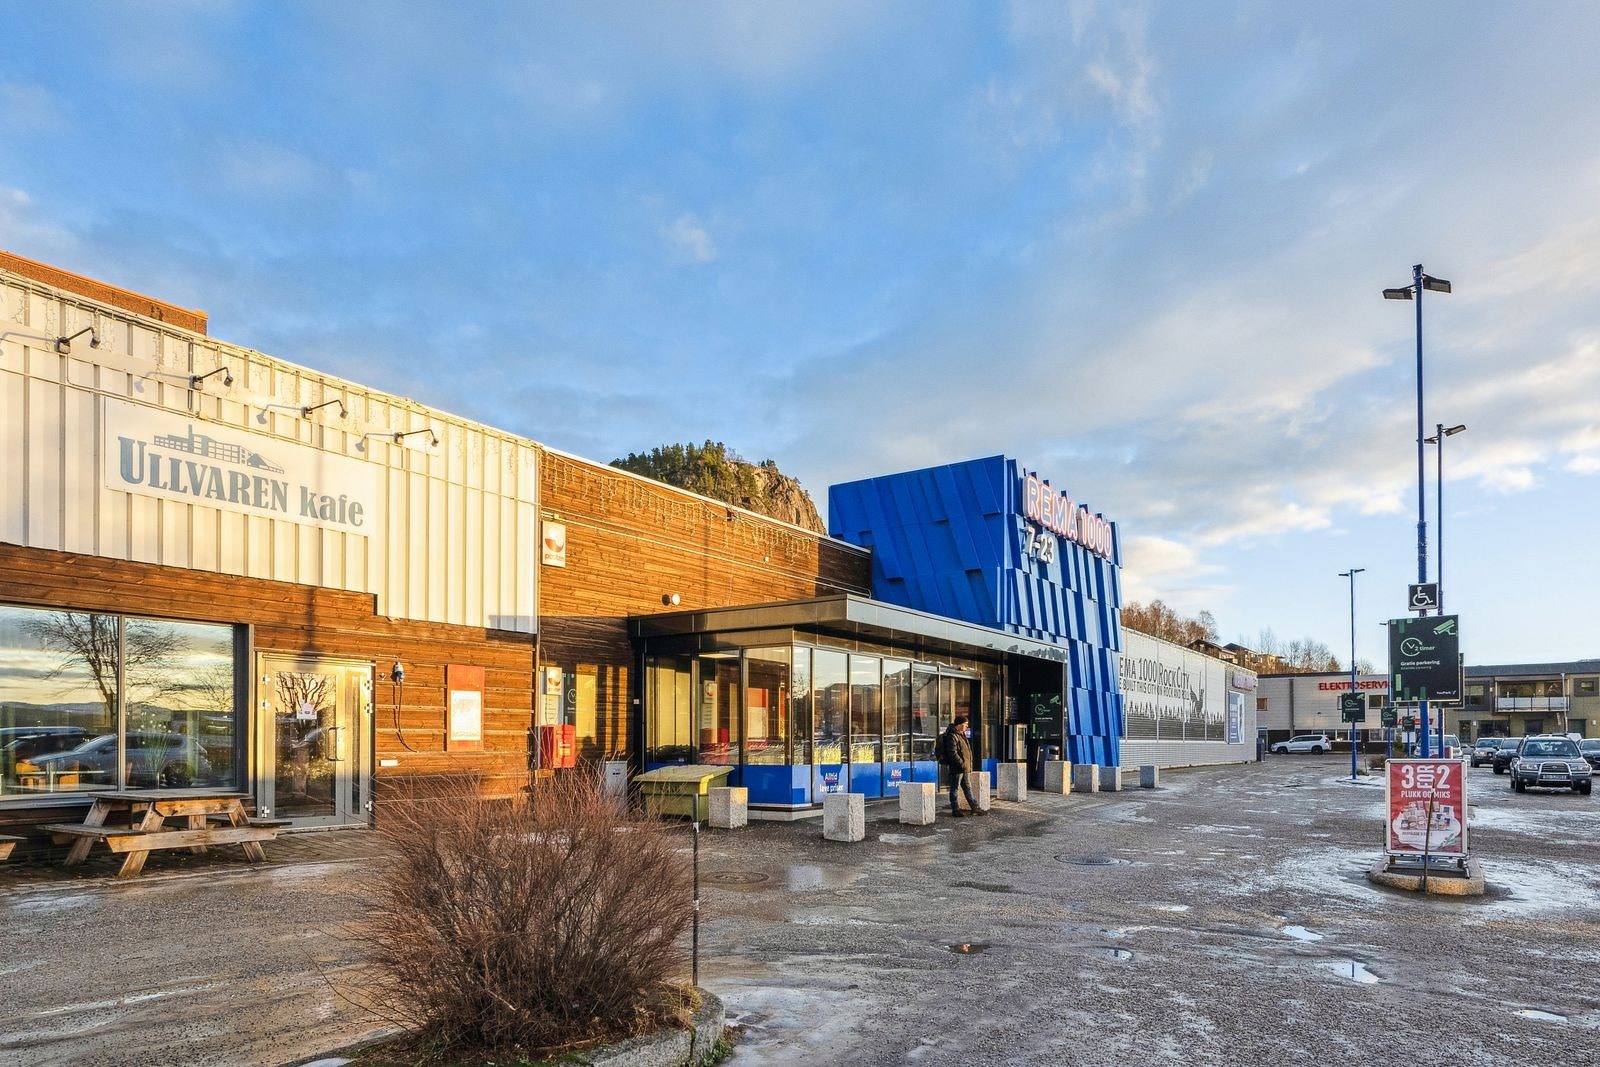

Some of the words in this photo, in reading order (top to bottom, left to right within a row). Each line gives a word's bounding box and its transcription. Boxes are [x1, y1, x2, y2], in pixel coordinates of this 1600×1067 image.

[117, 436, 289, 513] ULLVAREN
[299, 485, 364, 528] kafe
[1023, 475, 1078, 542] REMA
[1077, 507, 1113, 558] 1000
[1024, 526, 1054, 565] 7-23
[1139, 657, 1157, 681] 1000
[819, 783, 830, 793] lave
[829, 783, 844, 793] priser
[825, 772, 838, 780] Alltid
[1401, 764, 1415, 789] 3
[1416, 764, 1435, 789] FOR
[1436, 764, 1451, 789] 2
[1401, 790, 1421, 798] PLUKK
[1422, 790, 1432, 799] OG
[1433, 790, 1451, 799] MIKS
